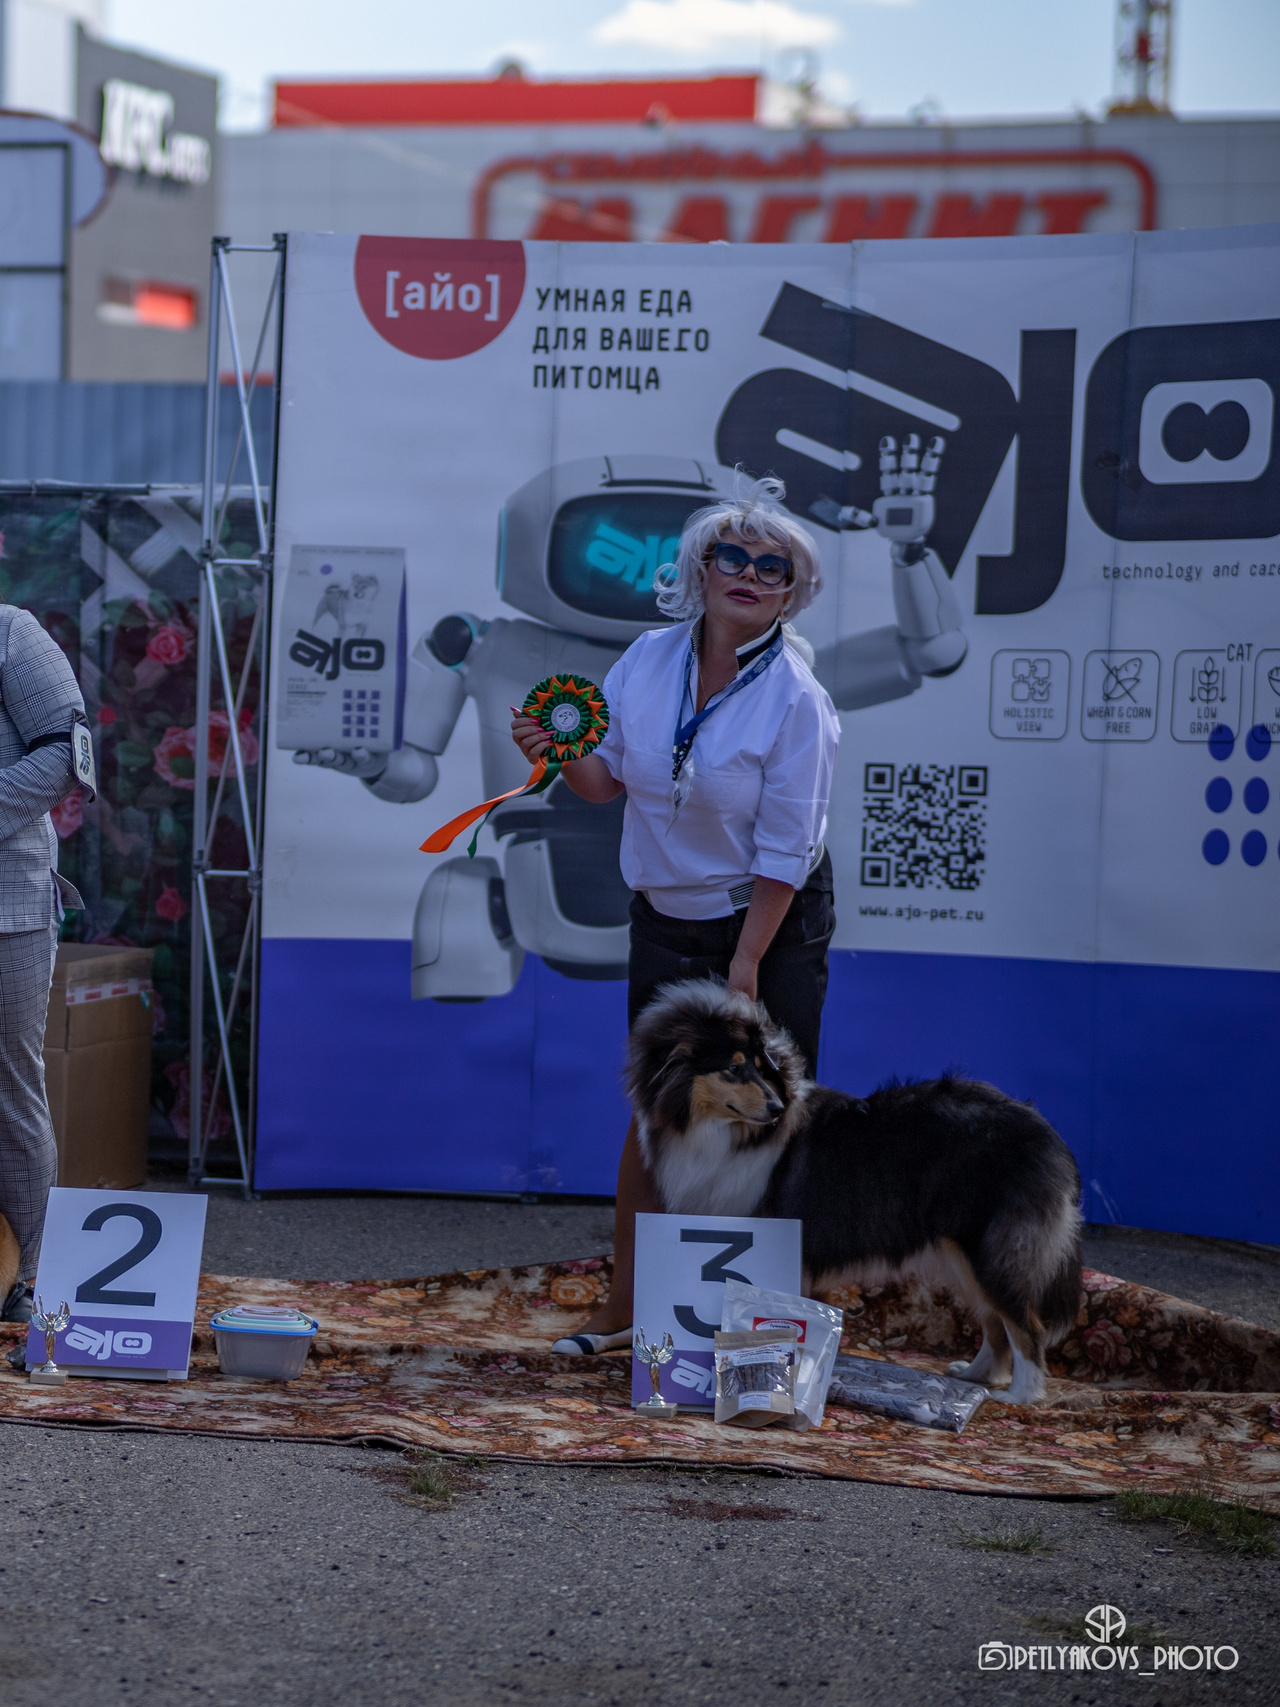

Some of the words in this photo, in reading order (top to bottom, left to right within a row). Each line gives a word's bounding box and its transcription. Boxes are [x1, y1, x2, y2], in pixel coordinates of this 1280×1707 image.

[386, 271, 499, 321] [айо]
[536, 287, 626, 313] УМНАЯ
[639, 289, 692, 317] ЕДА
[532, 326, 587, 354] ДЛЯ
[600, 327, 710, 352] ВАШЕГО
[533, 365, 660, 394] ПИТОМЦА
[1102, 562, 1203, 581] technology
[1212, 561, 1239, 577] and
[1226, 643, 1253, 661] CAT
[1003, 707, 1054, 718] HOLISTIC
[1086, 707, 1115, 718] WHEAT
[1117, 707, 1124, 718] &
[1126, 707, 1151, 718] CORN
[1197, 706, 1217, 719] LOW
[1016, 721, 1042, 732] VIEW
[1106, 721, 1131, 733] FREE
[1189, 721, 1223, 735] GRAIN
[859, 905, 984, 921] www.ajo-pet.ru
[74, 1202, 163, 1307] 2
[672, 1228, 754, 1339] 3
[65, 1323, 153, 1361] ajo
